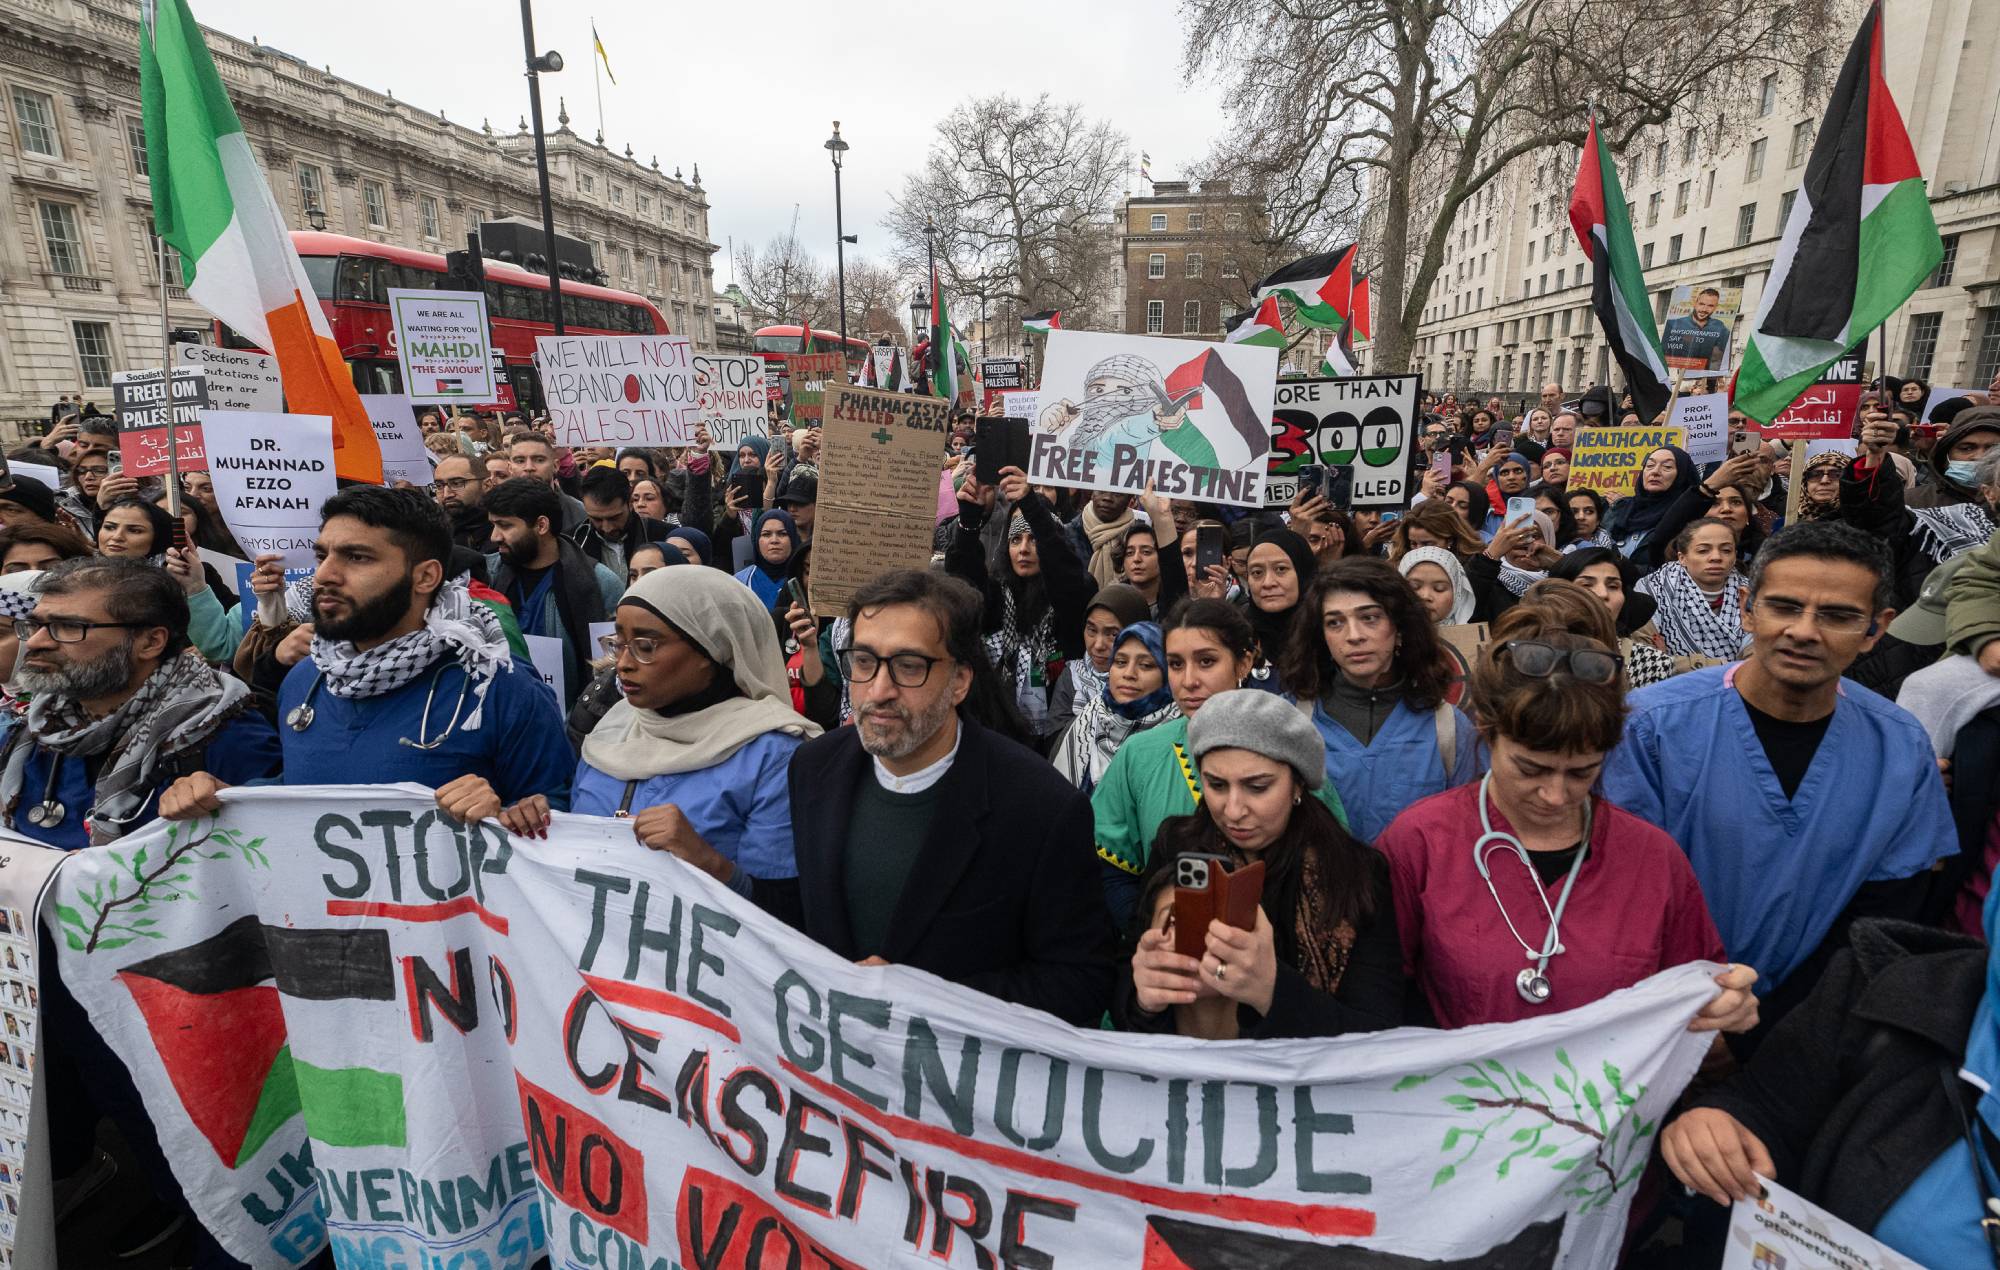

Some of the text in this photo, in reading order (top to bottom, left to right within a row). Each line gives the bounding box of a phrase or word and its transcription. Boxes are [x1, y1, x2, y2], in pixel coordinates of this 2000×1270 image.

[416, 310, 430, 318] WE
[449, 311, 465, 319] ALL
[407, 325, 442, 333] WAITING
[1695, 336, 1705, 344] TO
[411, 341, 481, 358] MAHDI
[540, 340, 690, 368] WE WILL NOT
[439, 365, 484, 374] SAVIOUR"
[692, 356, 759, 390] STOP
[985, 363, 1017, 374] FREEDOM
[265, 375, 279, 383] on
[804, 380, 828, 392] ONL
[985, 377, 1020, 388] PALESTINE
[239, 386, 259, 394] are
[654, 373, 696, 404] YOU
[1334, 379, 1403, 401] THAN
[224, 399, 251, 409] done
[840, 391, 949, 420] PHARMACISTS
[1684, 404, 1712, 414] PROF.
[549, 407, 699, 444] PALESTINE
[833, 404, 895, 426] KILLED
[906, 414, 945, 433] GAZA
[1683, 413, 1712, 423] SALAH
[704, 416, 768, 445] OSPITALS
[250, 438, 281, 452] DR.
[1266, 406, 1404, 477] 300
[1575, 431, 1678, 448] HEALTHCARE
[216, 456, 325, 472] MUHANNAD
[1573, 452, 1637, 467] WORKERS
[1031, 433, 1260, 504] FREE PALESTINE
[246, 477, 292, 490] EZZO
[1354, 478, 1401, 499] LLED
[235, 496, 309, 510] AFANAH
[313, 808, 1372, 1194] STOP THE GENOCIDE
[528, 1094, 622, 1215] NO
